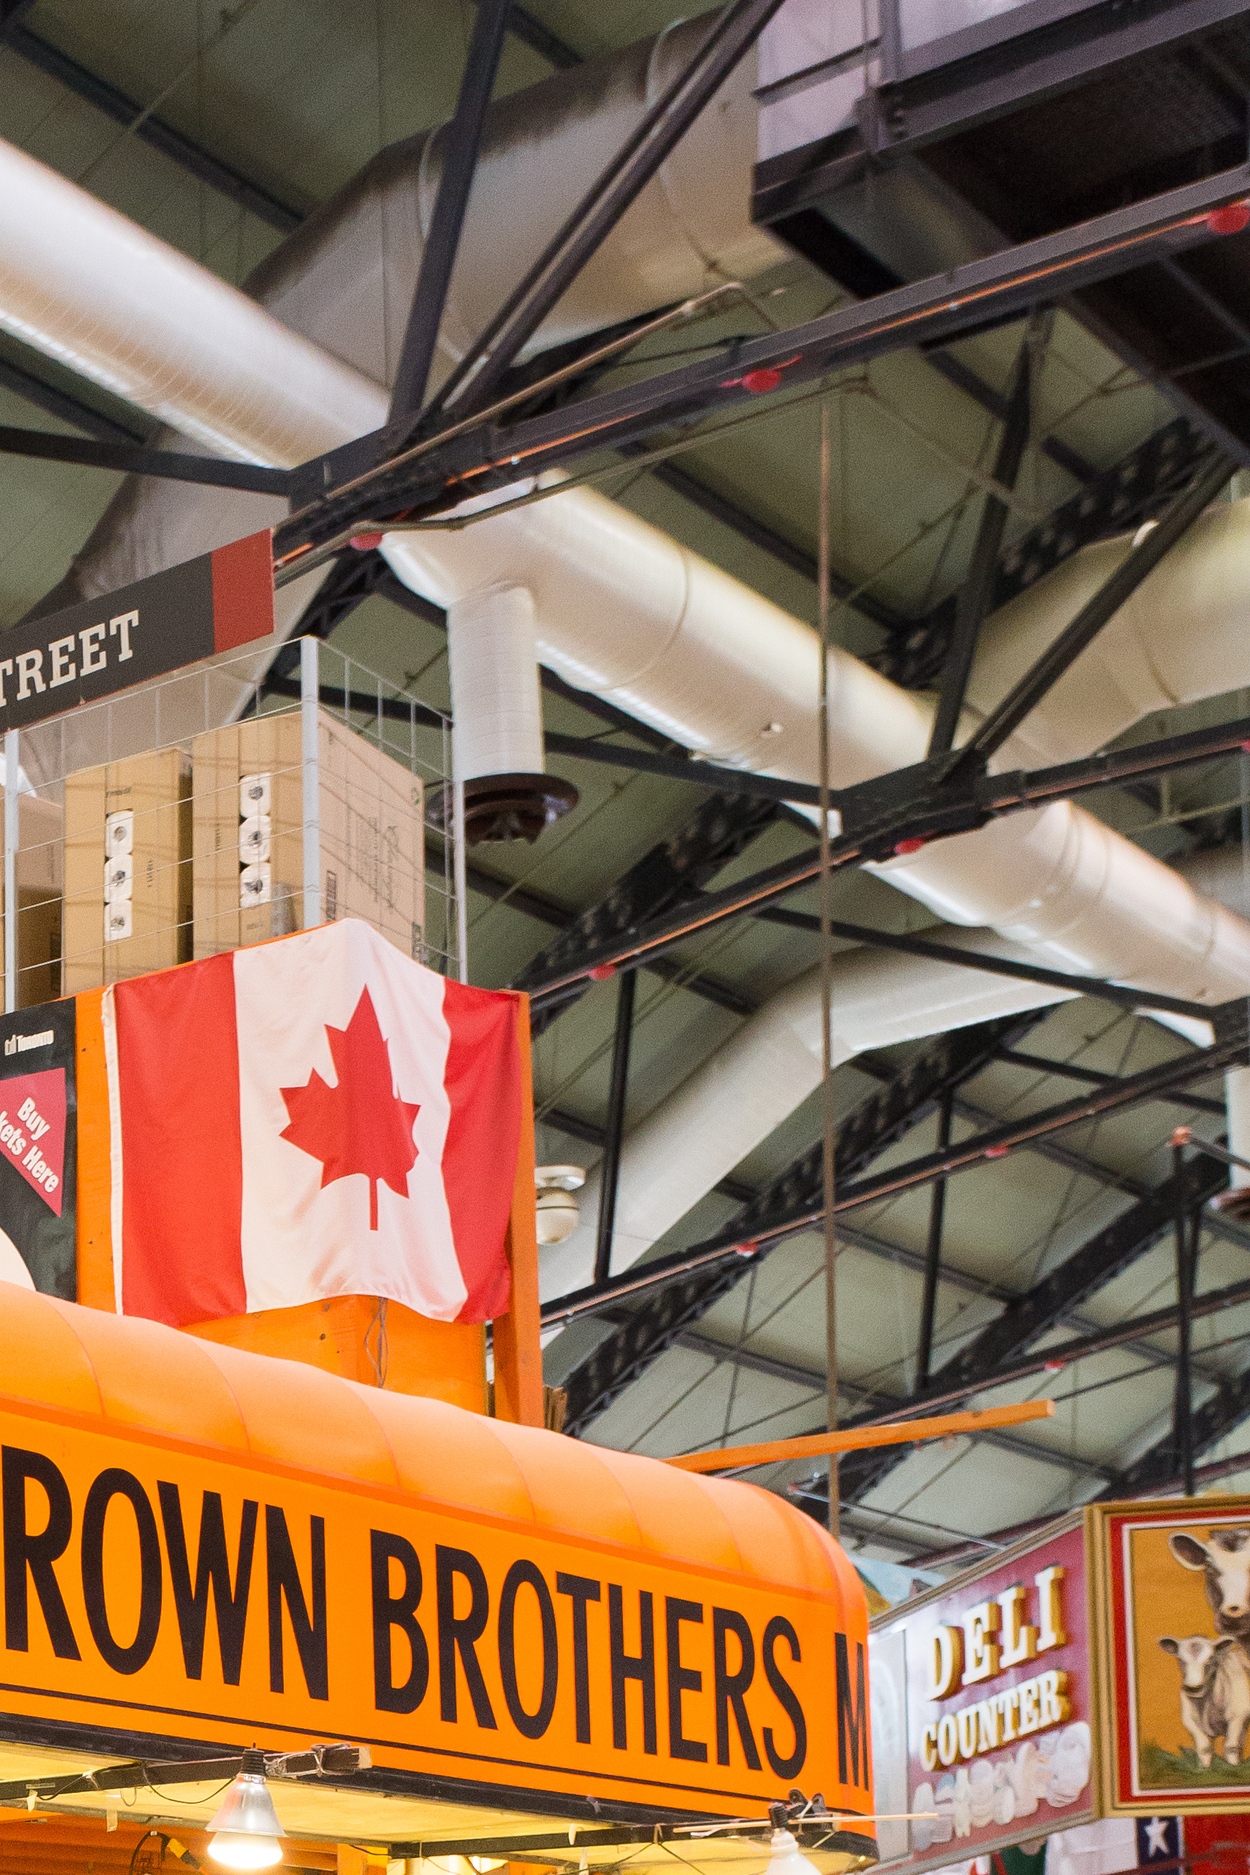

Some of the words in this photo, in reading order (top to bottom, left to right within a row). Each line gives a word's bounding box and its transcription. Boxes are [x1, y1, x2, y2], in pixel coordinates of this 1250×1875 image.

[18, 1097, 50, 1141] Buy
[21, 1145, 59, 1193] Here
[370, 1529, 807, 1780] BROTHERS
[834, 1632, 869, 1791] M
[927, 1566, 1066, 1701] DELI
[920, 1670, 1071, 1772] COUNTER
